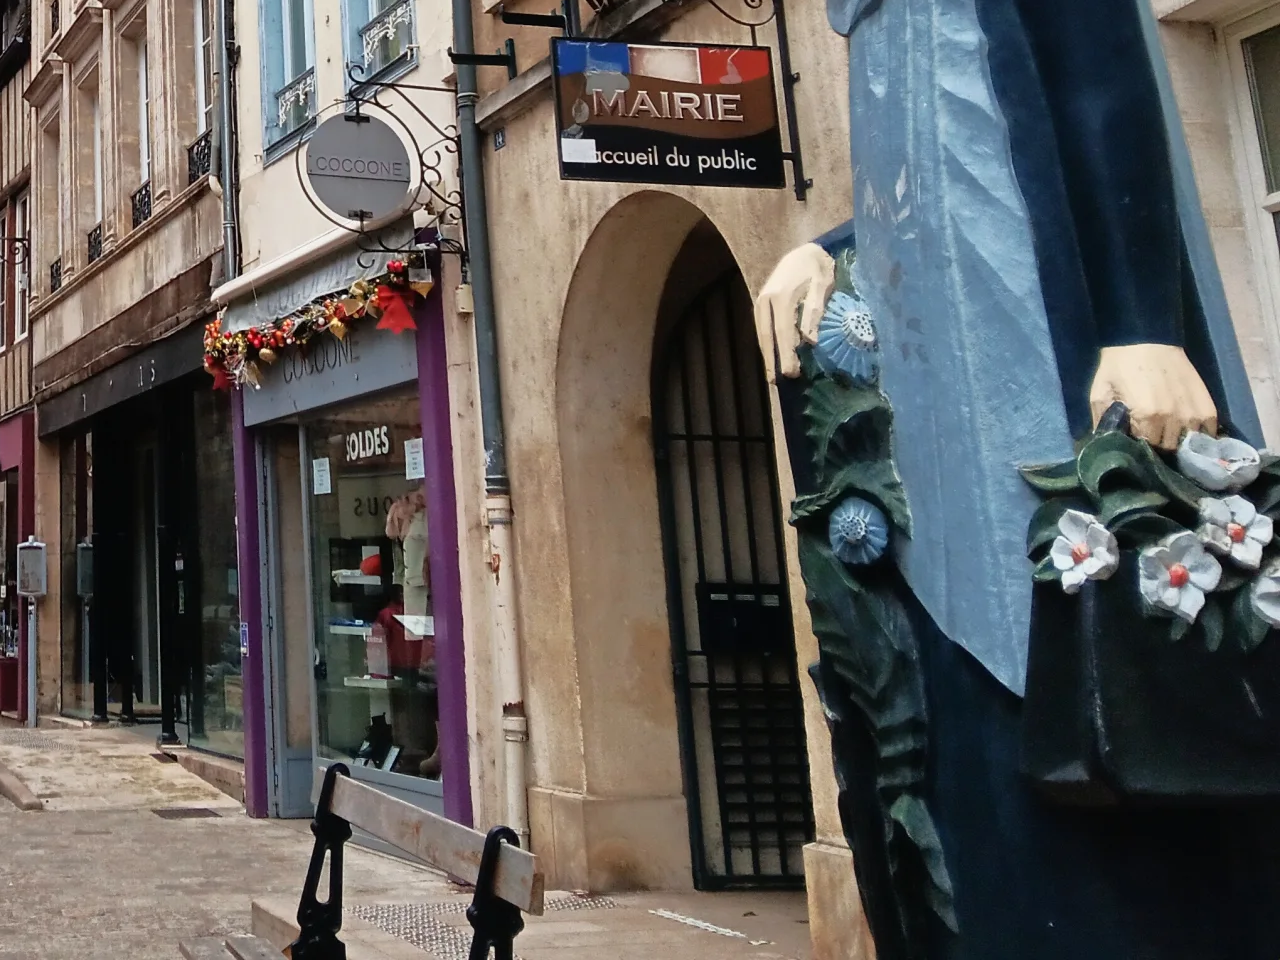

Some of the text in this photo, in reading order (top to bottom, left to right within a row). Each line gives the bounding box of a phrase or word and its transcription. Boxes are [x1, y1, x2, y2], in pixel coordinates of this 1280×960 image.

[592, 88, 744, 123] MAIRIE
[316, 156, 403, 177] COCOONE
[665, 146, 691, 168] du
[698, 148, 758, 174] public
[282, 334, 361, 384] COCOONE
